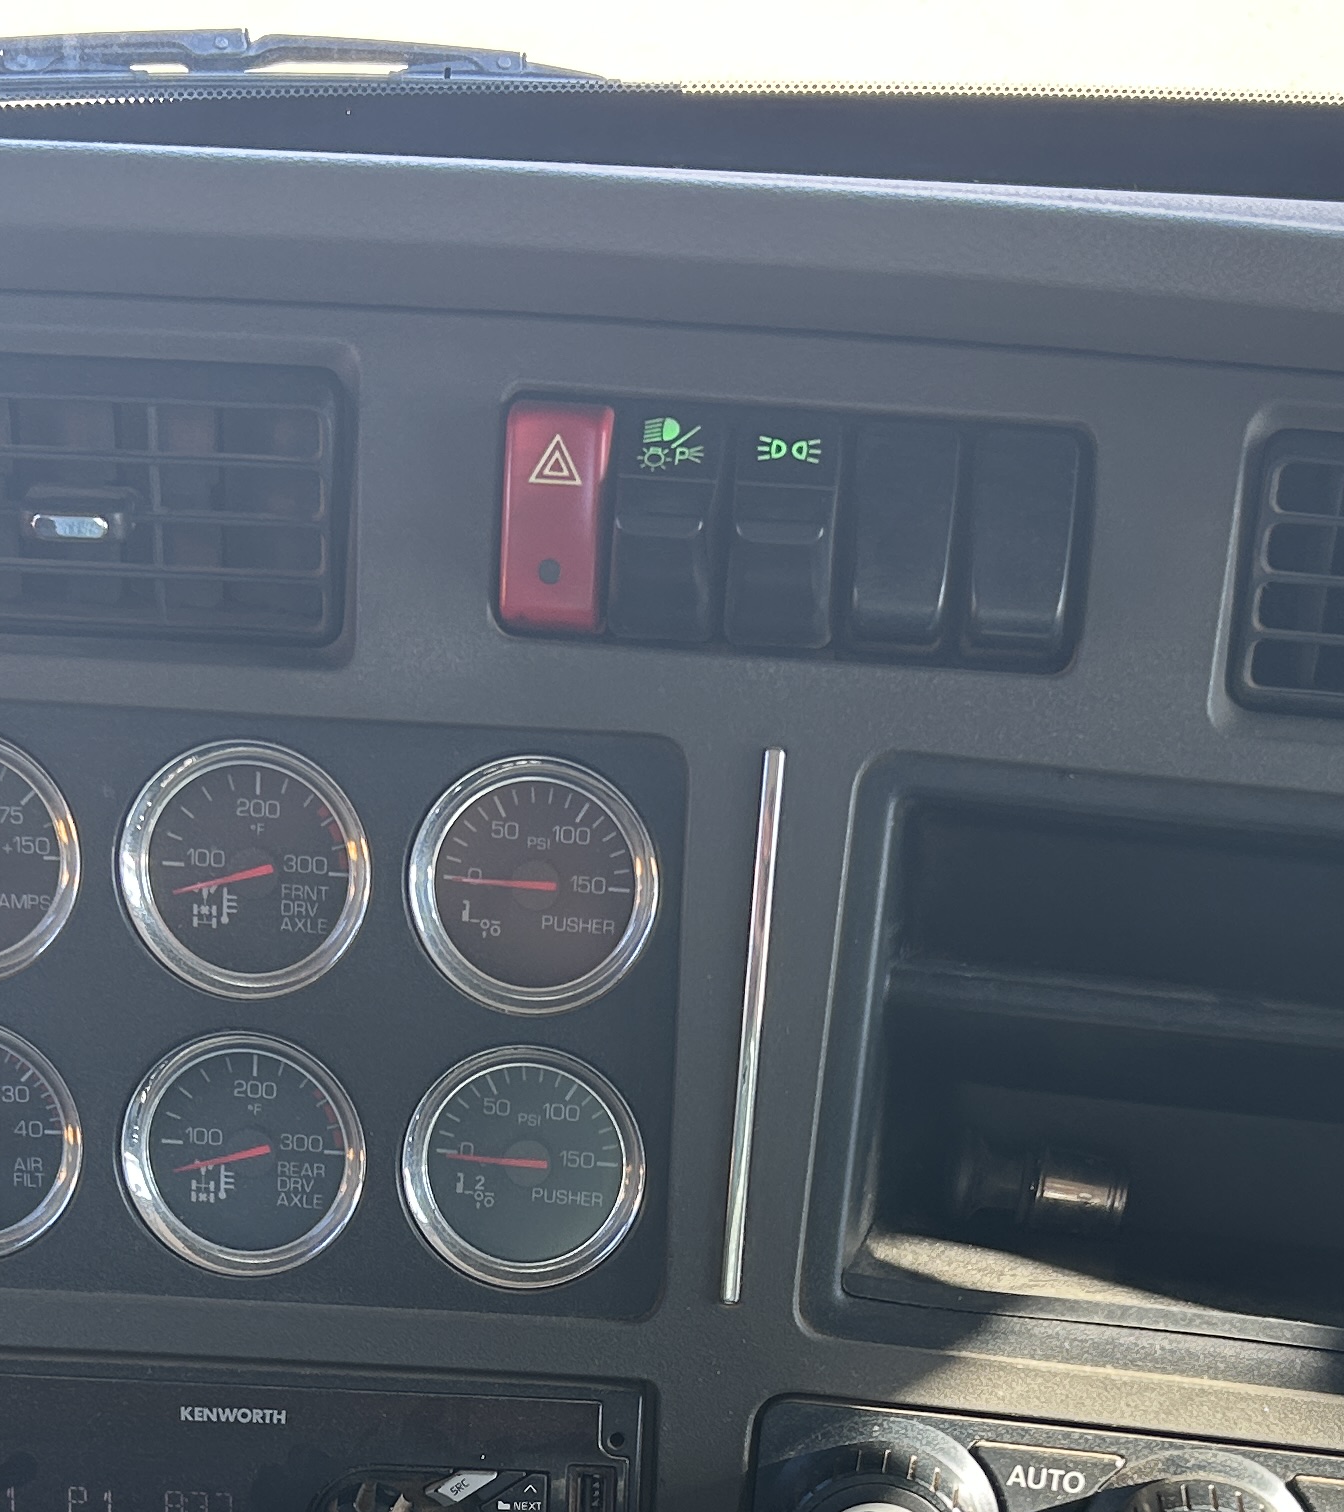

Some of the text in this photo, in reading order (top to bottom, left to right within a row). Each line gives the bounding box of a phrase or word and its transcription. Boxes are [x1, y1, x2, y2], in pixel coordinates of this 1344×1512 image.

[236, 799, 280, 818] 200
[491, 821, 519, 840] 50
[552, 826, 591, 845] 100
[2, 837, 50, 854] +150
[527, 836, 551, 850] PSI
[187, 849, 225, 867] 100
[283, 855, 327, 874] 300
[468, 868, 482, 884] 0
[571, 876, 606, 894] 150
[281, 884, 329, 901] FRNT
[280, 900, 319, 917] DRV
[280, 917, 328, 934] AXLE
[542, 915, 615, 935] PUSHER
[1, 1086, 29, 1102] 30
[234, 1080, 277, 1099] 200
[483, 1098, 510, 1116] 50
[543, 1103, 580, 1121] 100
[14, 1120, 43, 1137] 40
[518, 1113, 541, 1126] PSI
[185, 1127, 222, 1145] 100
[280, 1133, 323, 1151] 300
[460, 1142, 474, 1157] 0
[14, 1157, 43, 1171] AIR
[559, 1151, 595, 1169] 150
[277, 1162, 325, 1178] REAR
[13, 1173, 44, 1188] FILT
[277, 1178, 315, 1193] DRV
[277, 1194, 323, 1209] AXLE
[532, 1188, 603, 1207] PUSHER
[180, 1406, 287, 1425] KENWORTH
[449, 1478, 470, 1496] SRC
[1006, 1465, 1086, 1494] AUTO
[513, 1501, 542, 1511] NEXT
